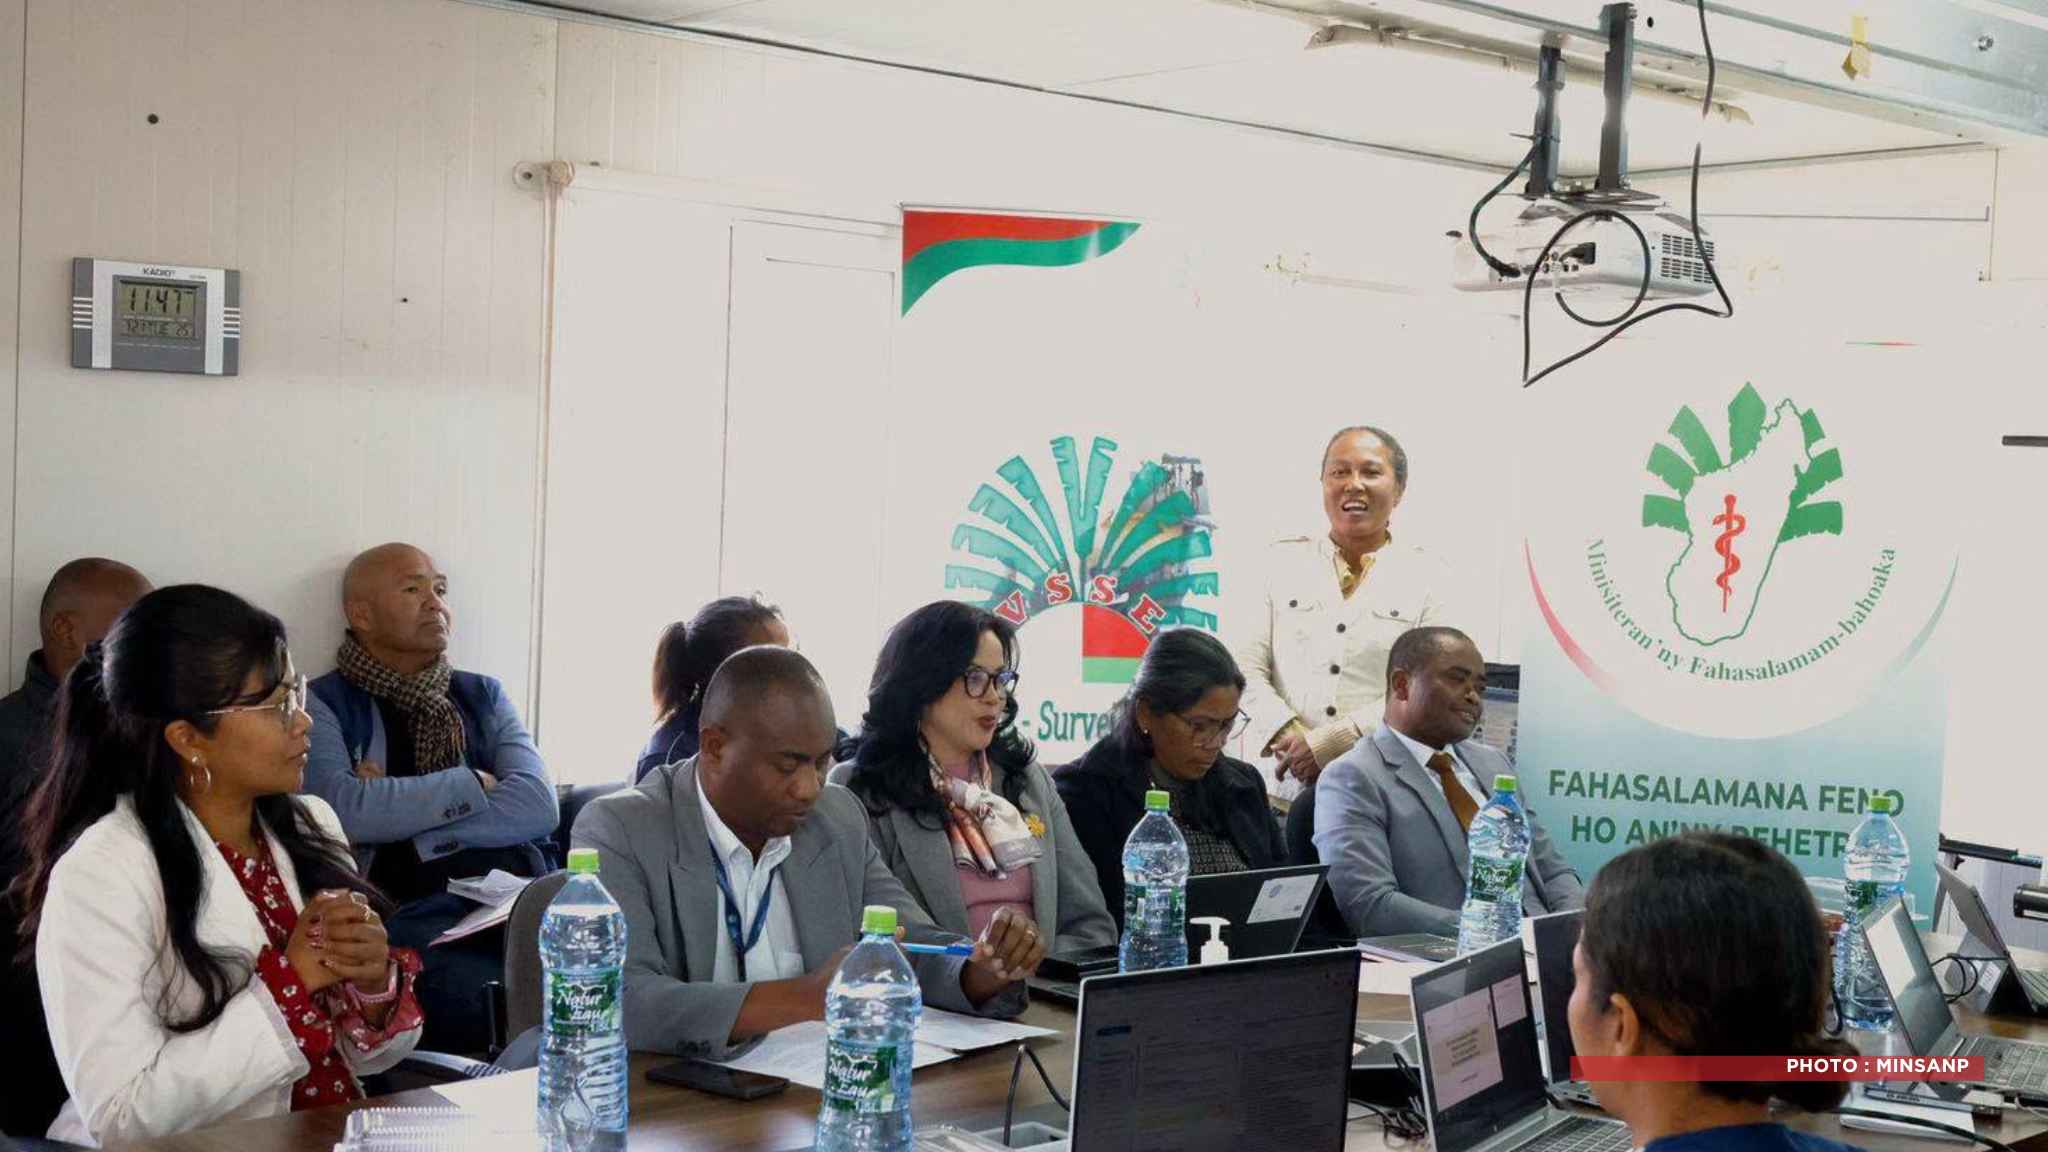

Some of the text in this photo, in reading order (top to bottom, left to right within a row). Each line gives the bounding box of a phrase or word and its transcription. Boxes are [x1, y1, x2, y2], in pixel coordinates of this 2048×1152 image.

[1688, 547, 1896, 682] Fahasalamam-bahoaka
[1548, 769, 1808, 812] FAHASALAMANA
[1571, 815, 1616, 845] HO
[556, 988, 603, 1007] Natur
[828, 1057, 872, 1082] Natur
